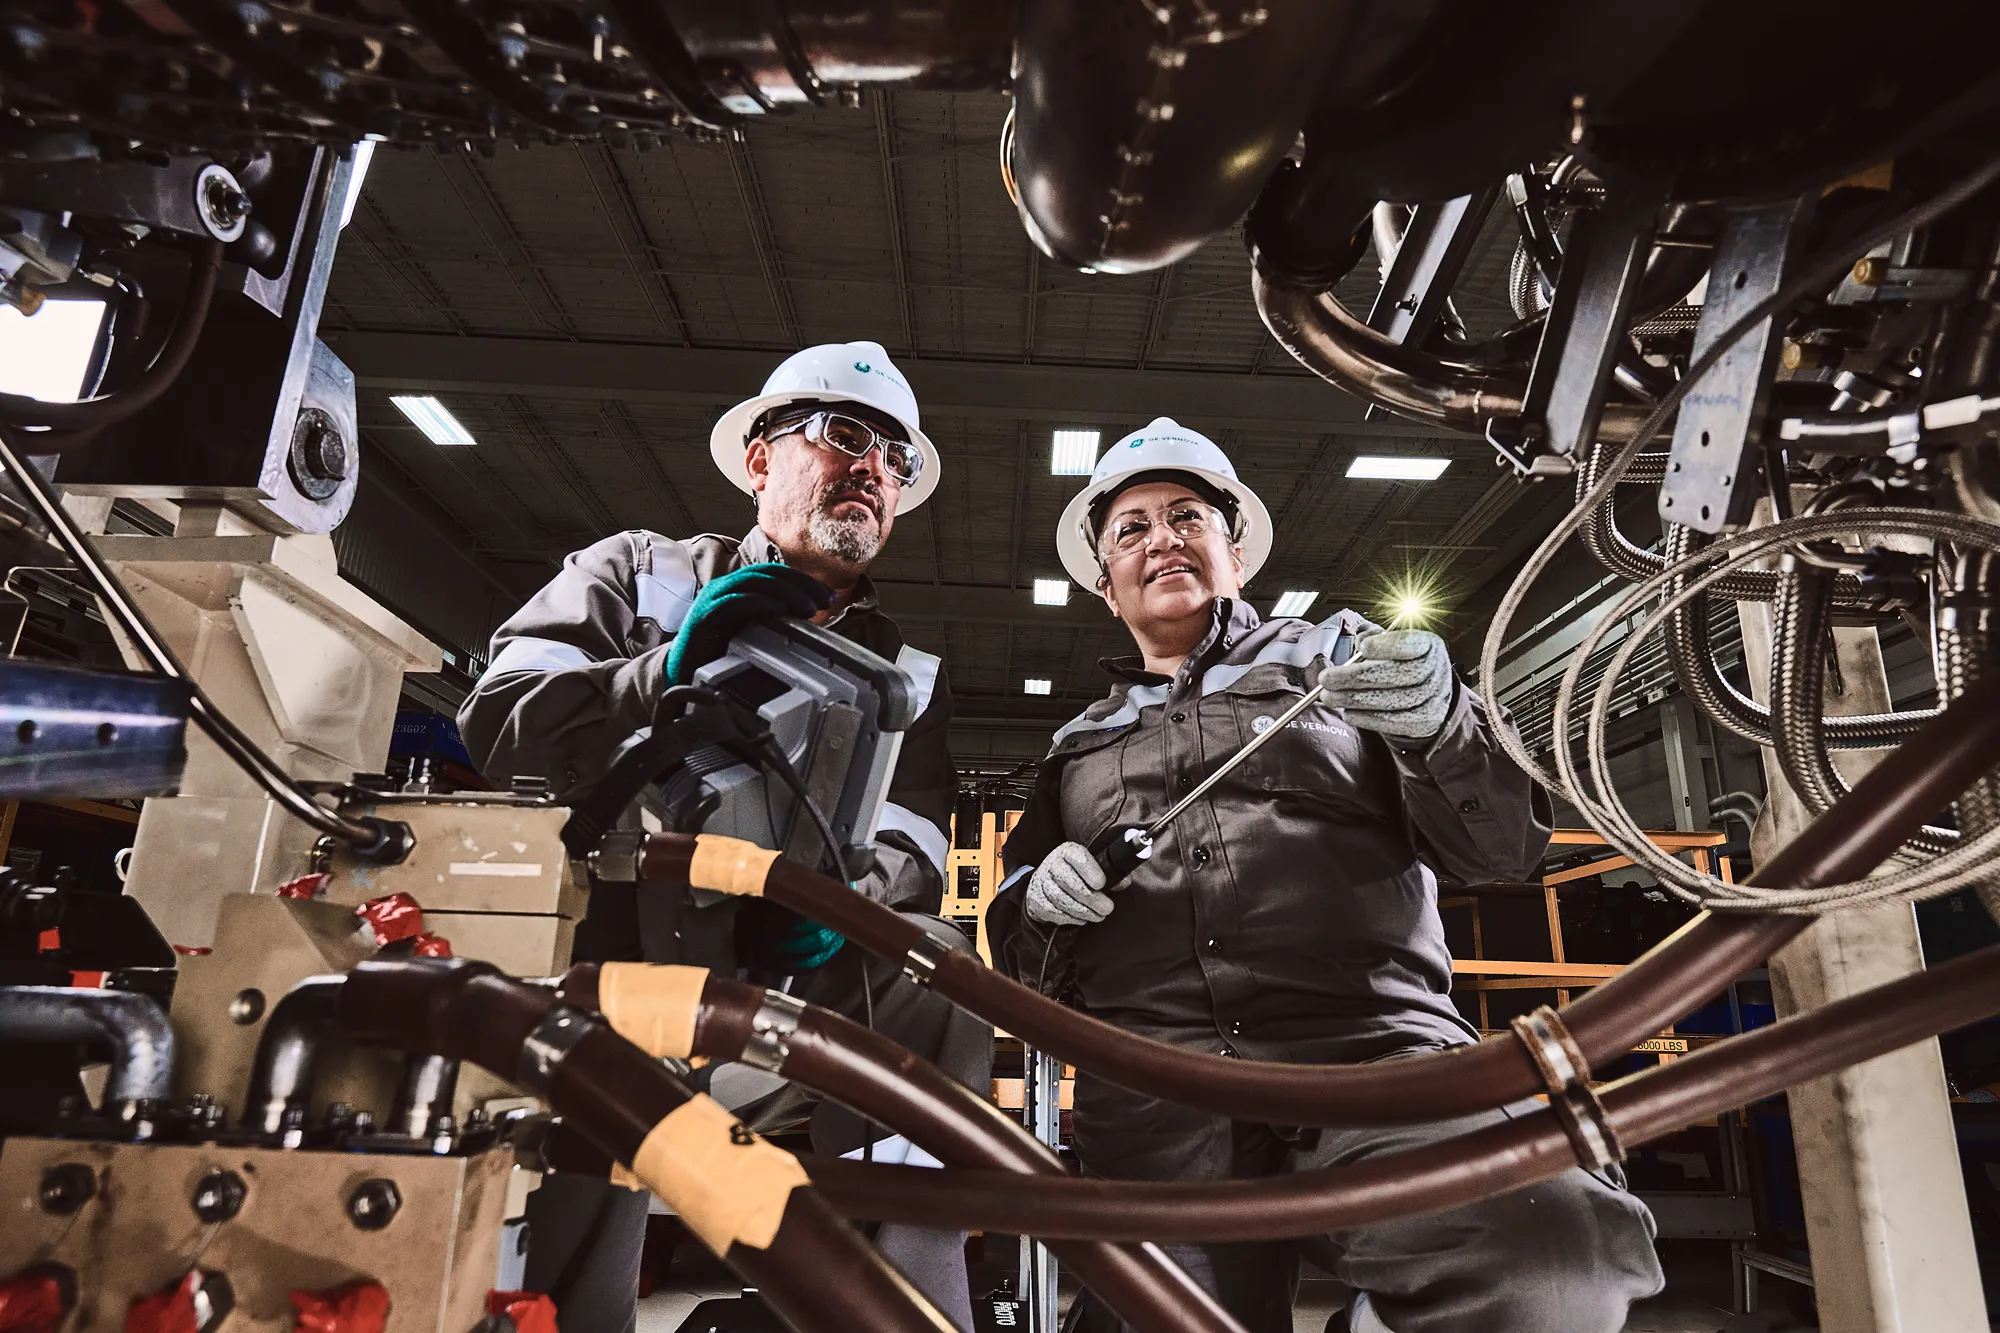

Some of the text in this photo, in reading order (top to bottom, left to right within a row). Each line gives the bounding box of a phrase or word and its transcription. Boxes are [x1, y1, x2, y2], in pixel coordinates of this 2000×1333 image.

[1161, 436, 1199, 446] VERNOVA
[1300, 720, 1350, 738] VERNOVA
[1663, 1042, 1683, 1051] LBS
[993, 1301, 1016, 1326] PROTO
